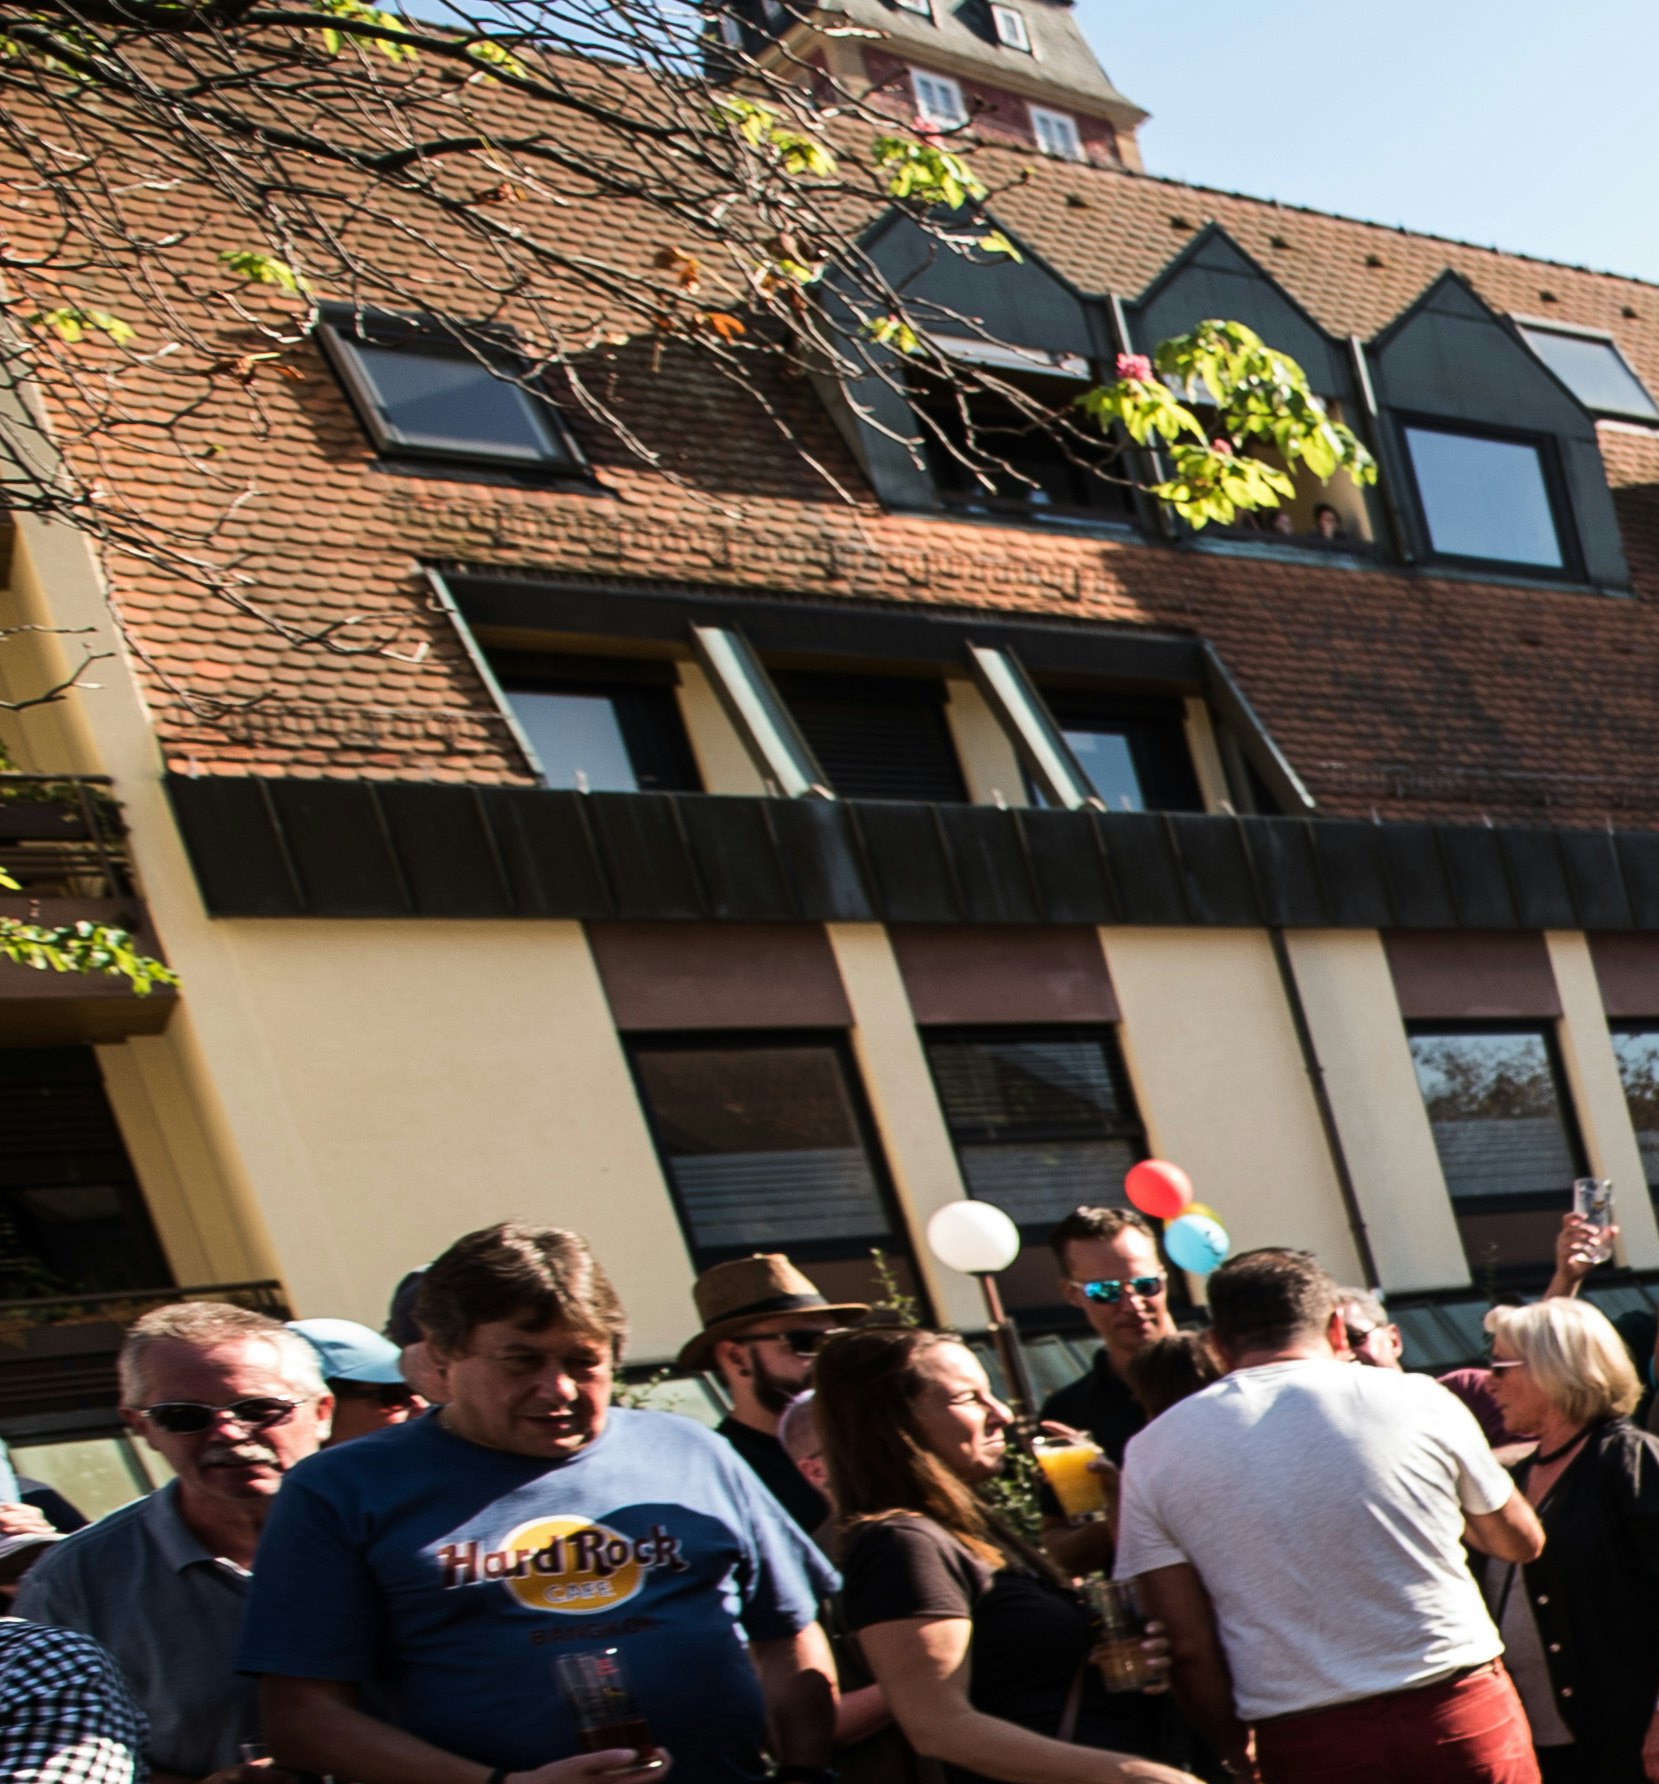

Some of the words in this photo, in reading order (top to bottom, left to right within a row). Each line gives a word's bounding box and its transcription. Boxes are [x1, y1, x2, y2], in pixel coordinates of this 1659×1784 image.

[437, 1534, 564, 1590] Hard
[566, 1524, 691, 1577] Rock
[543, 1580, 616, 1603] CAFE
